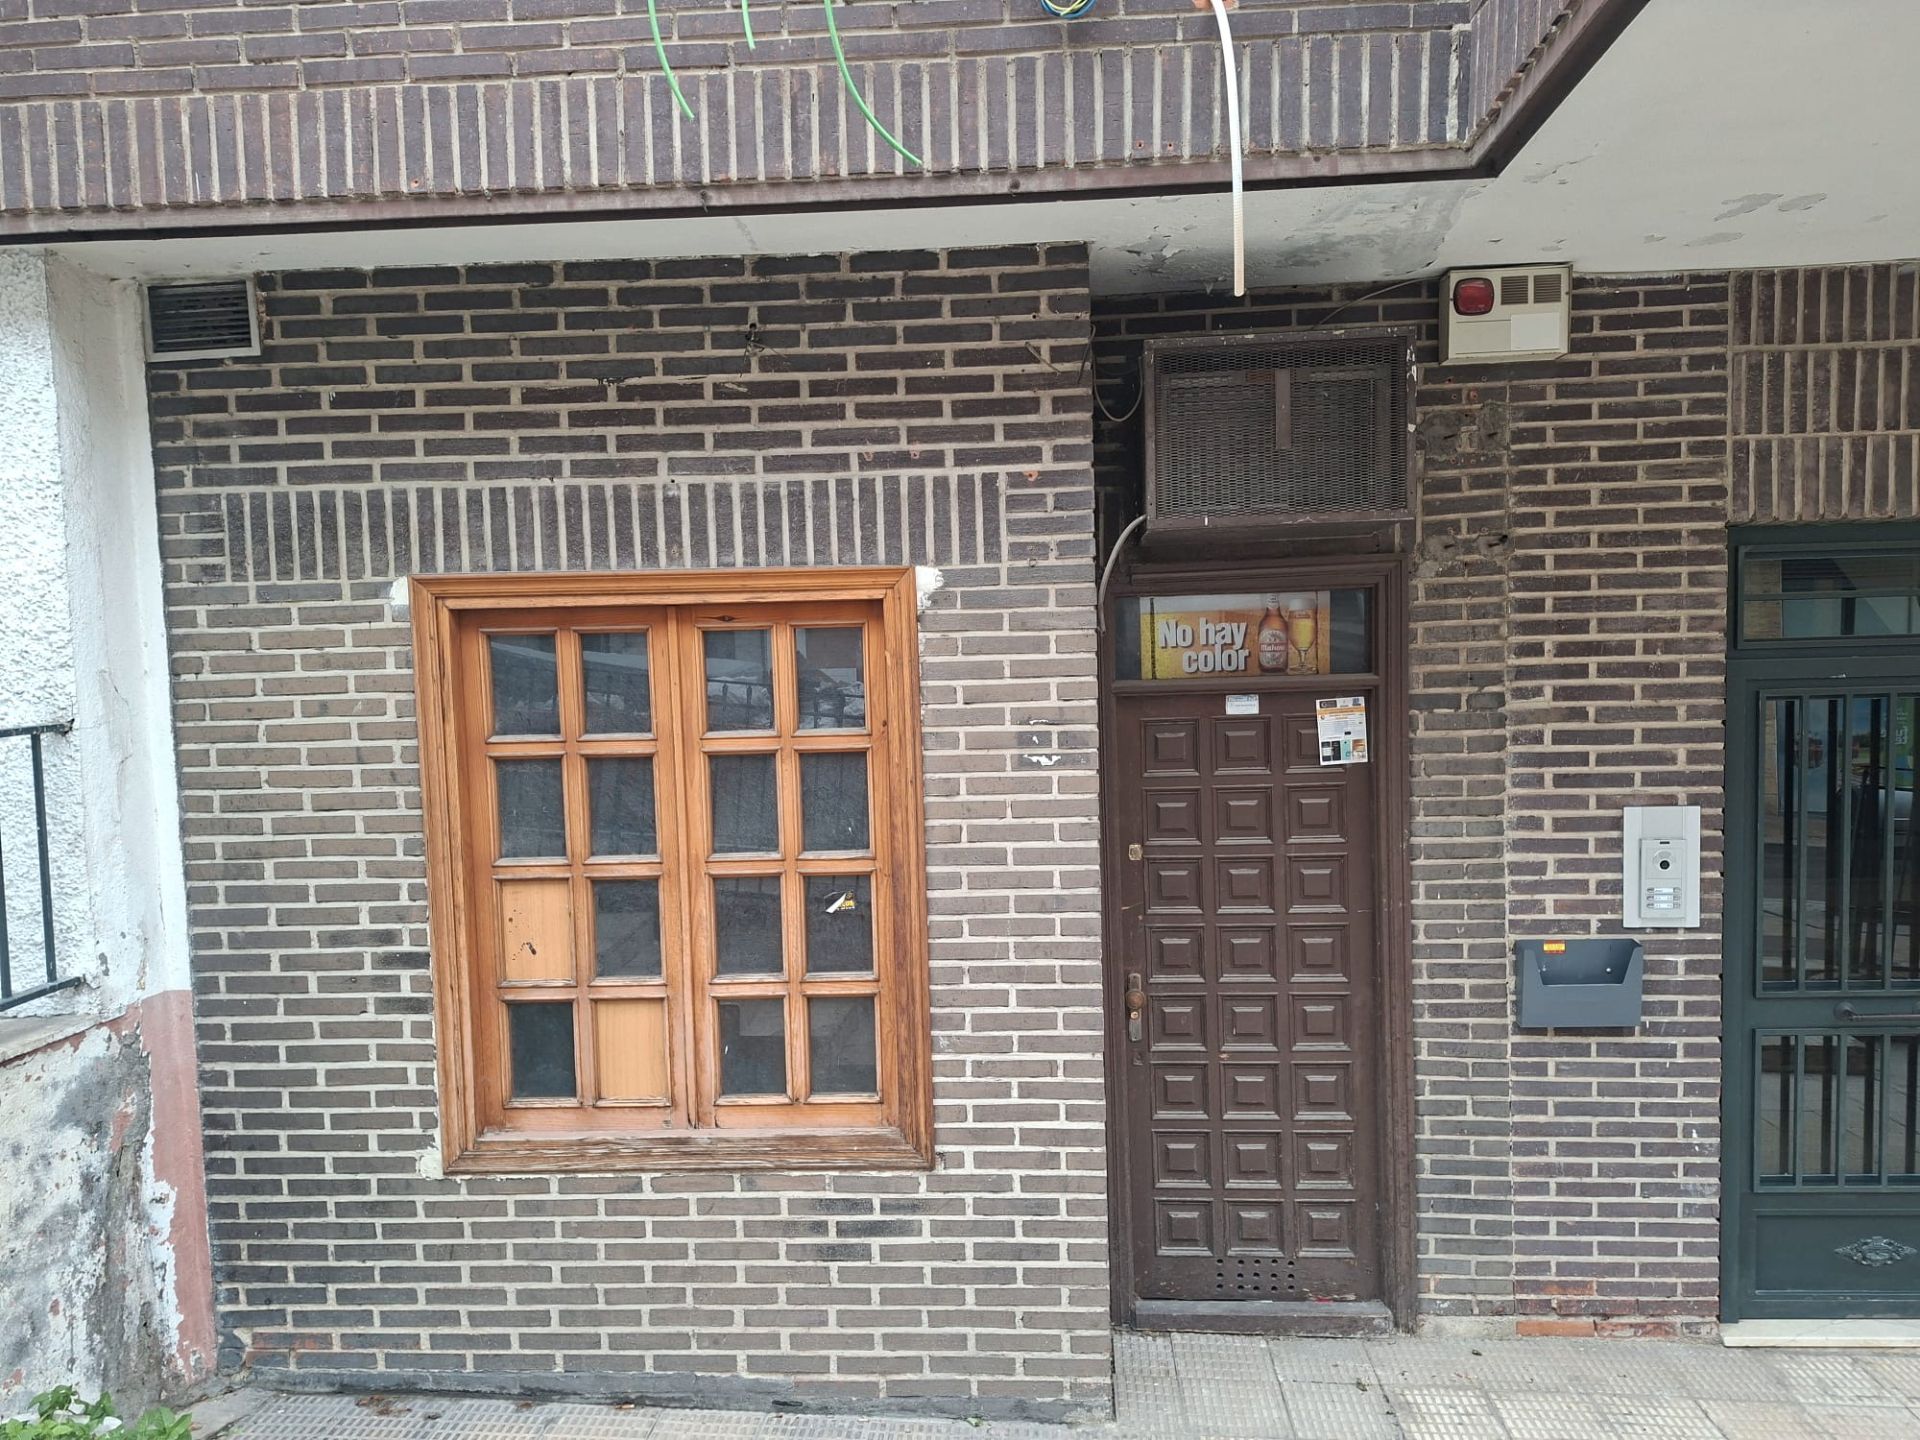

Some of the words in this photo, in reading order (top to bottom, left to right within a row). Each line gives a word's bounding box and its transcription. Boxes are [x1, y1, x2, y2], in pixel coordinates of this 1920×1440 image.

[1159, 619, 1193, 647] No
[1199, 617, 1247, 650] hay
[1183, 643, 1250, 673] color
